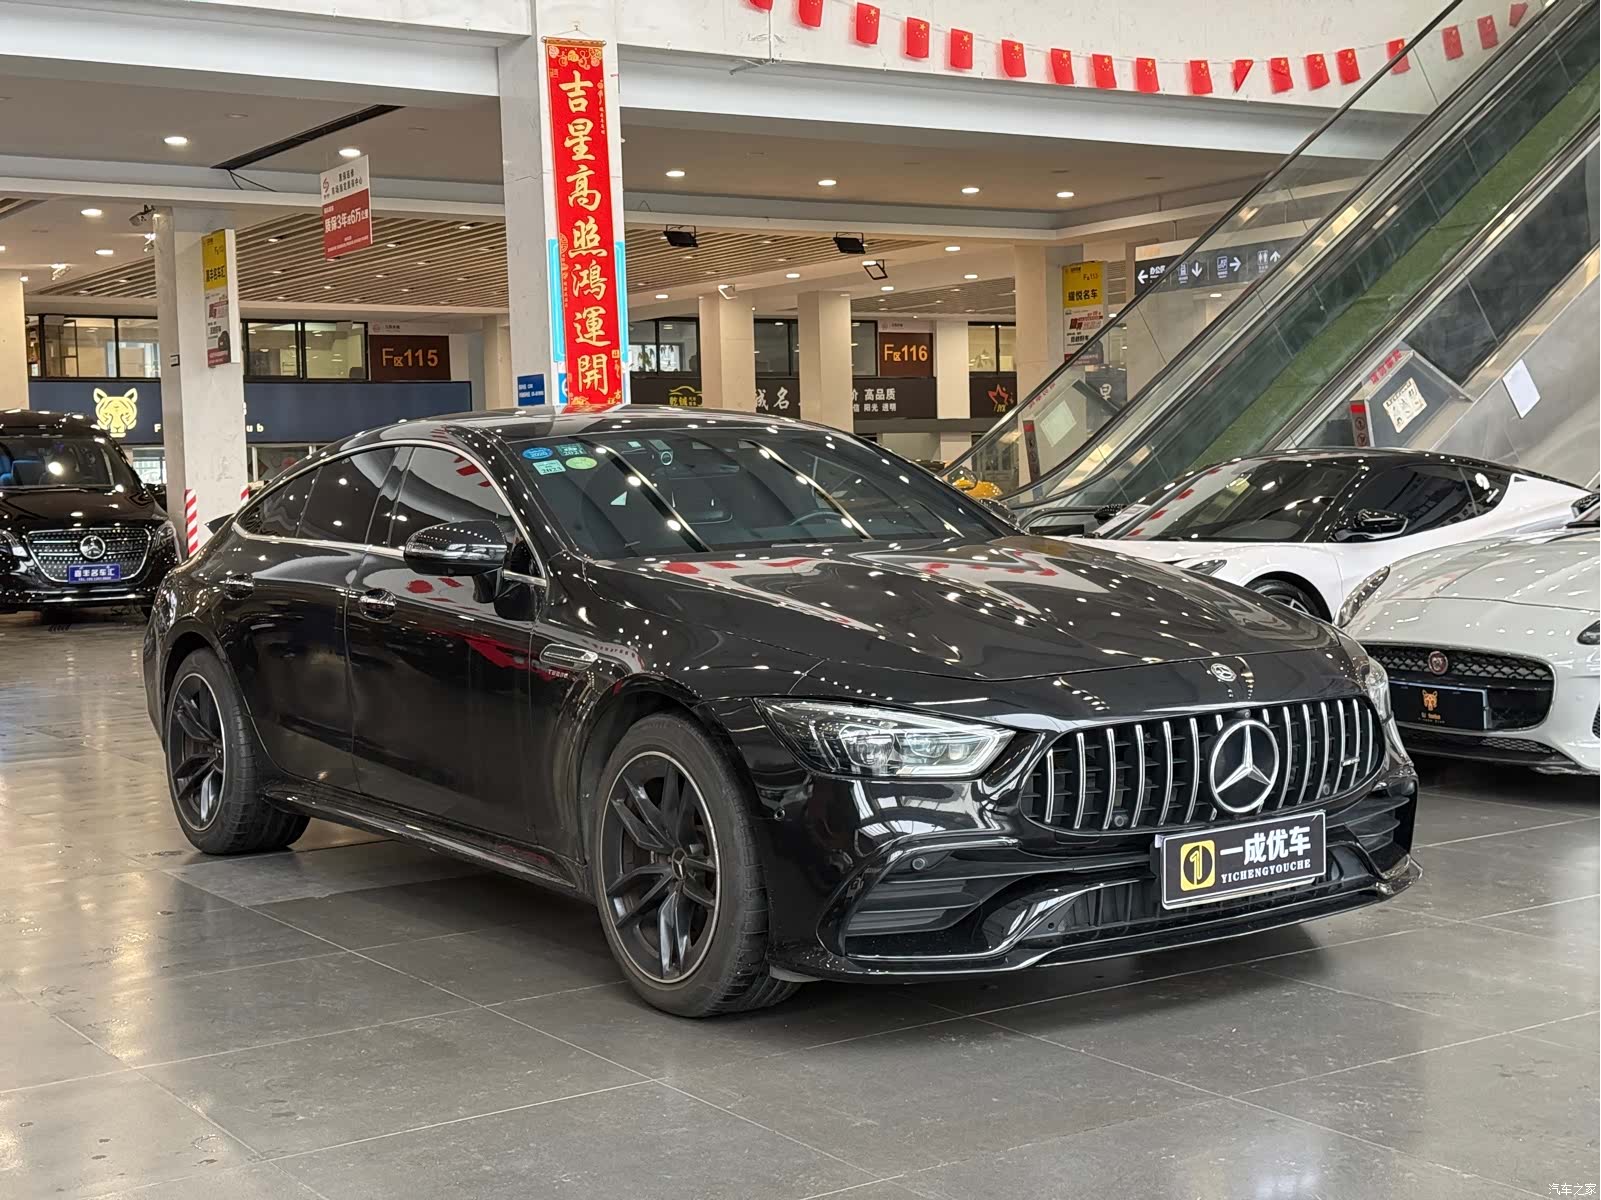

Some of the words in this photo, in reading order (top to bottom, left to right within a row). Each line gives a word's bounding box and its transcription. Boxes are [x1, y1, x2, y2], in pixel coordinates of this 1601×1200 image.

[558, 69, 612, 395] 吉星高照鴻運開
[382, 347, 439, 367] F区115
[884, 343, 928, 362] F区116
[864, 387, 896, 401] 高品质
[863, 403, 879, 412] 阳光
[881, 402, 897, 412] 透明
[1219, 826, 1312, 866] 一成优车
[1220, 858, 1312, 885] YICHENGYOUCHE
